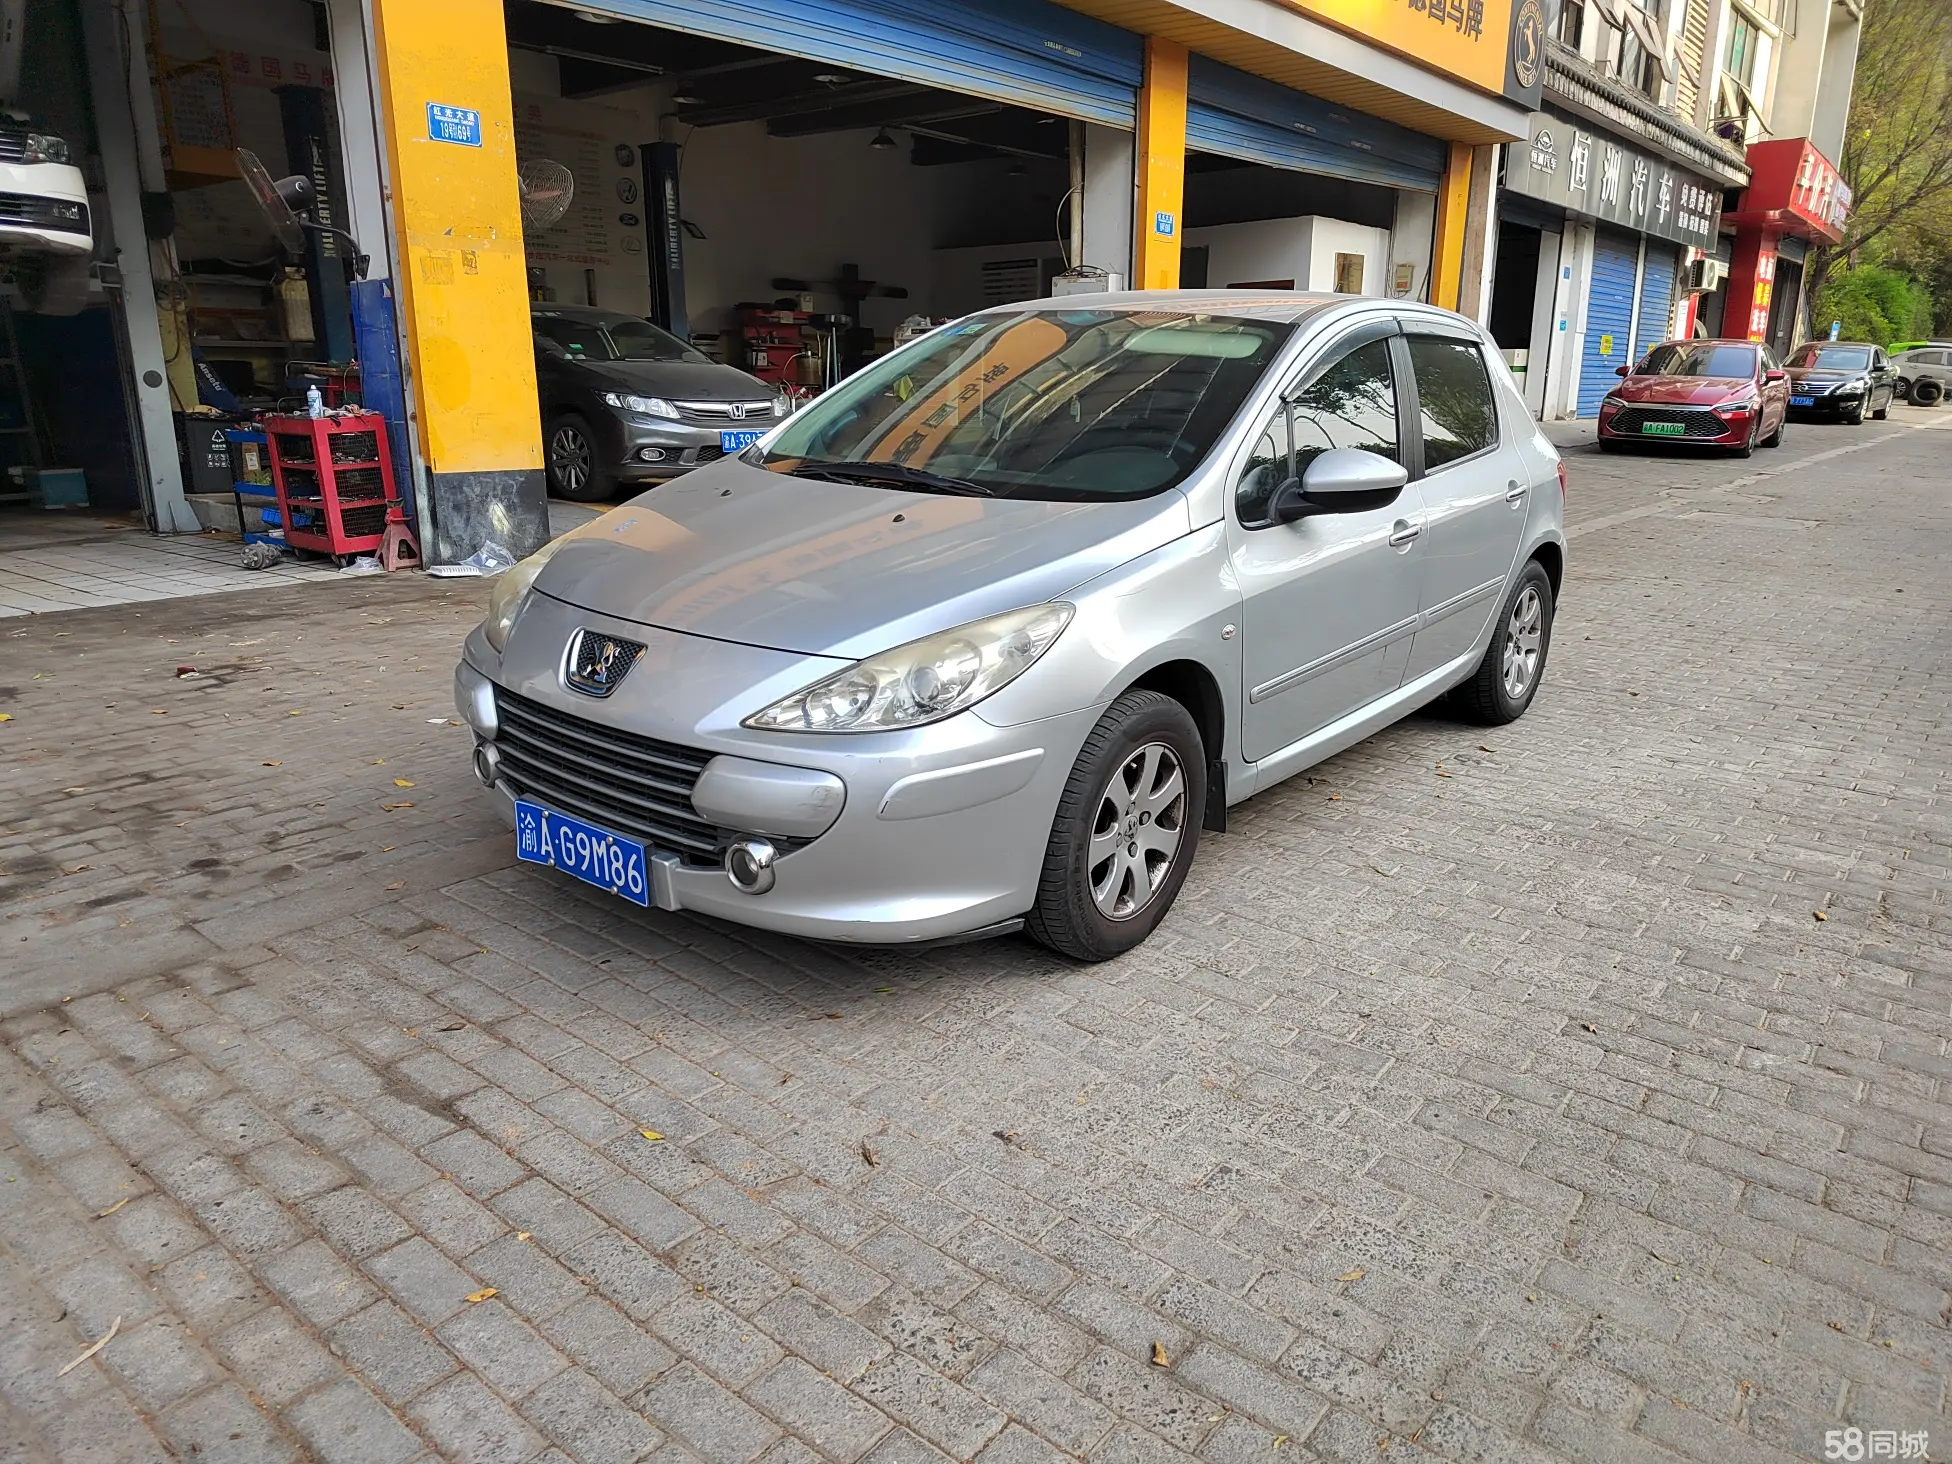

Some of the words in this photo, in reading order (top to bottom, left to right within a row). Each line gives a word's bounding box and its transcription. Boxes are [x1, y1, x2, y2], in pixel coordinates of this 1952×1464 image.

[1407, 0, 1484, 42] 国马牌
[1567, 130, 1673, 224] 恒洲汽车
[520, 812, 642, 894] 渝A·G9M86
